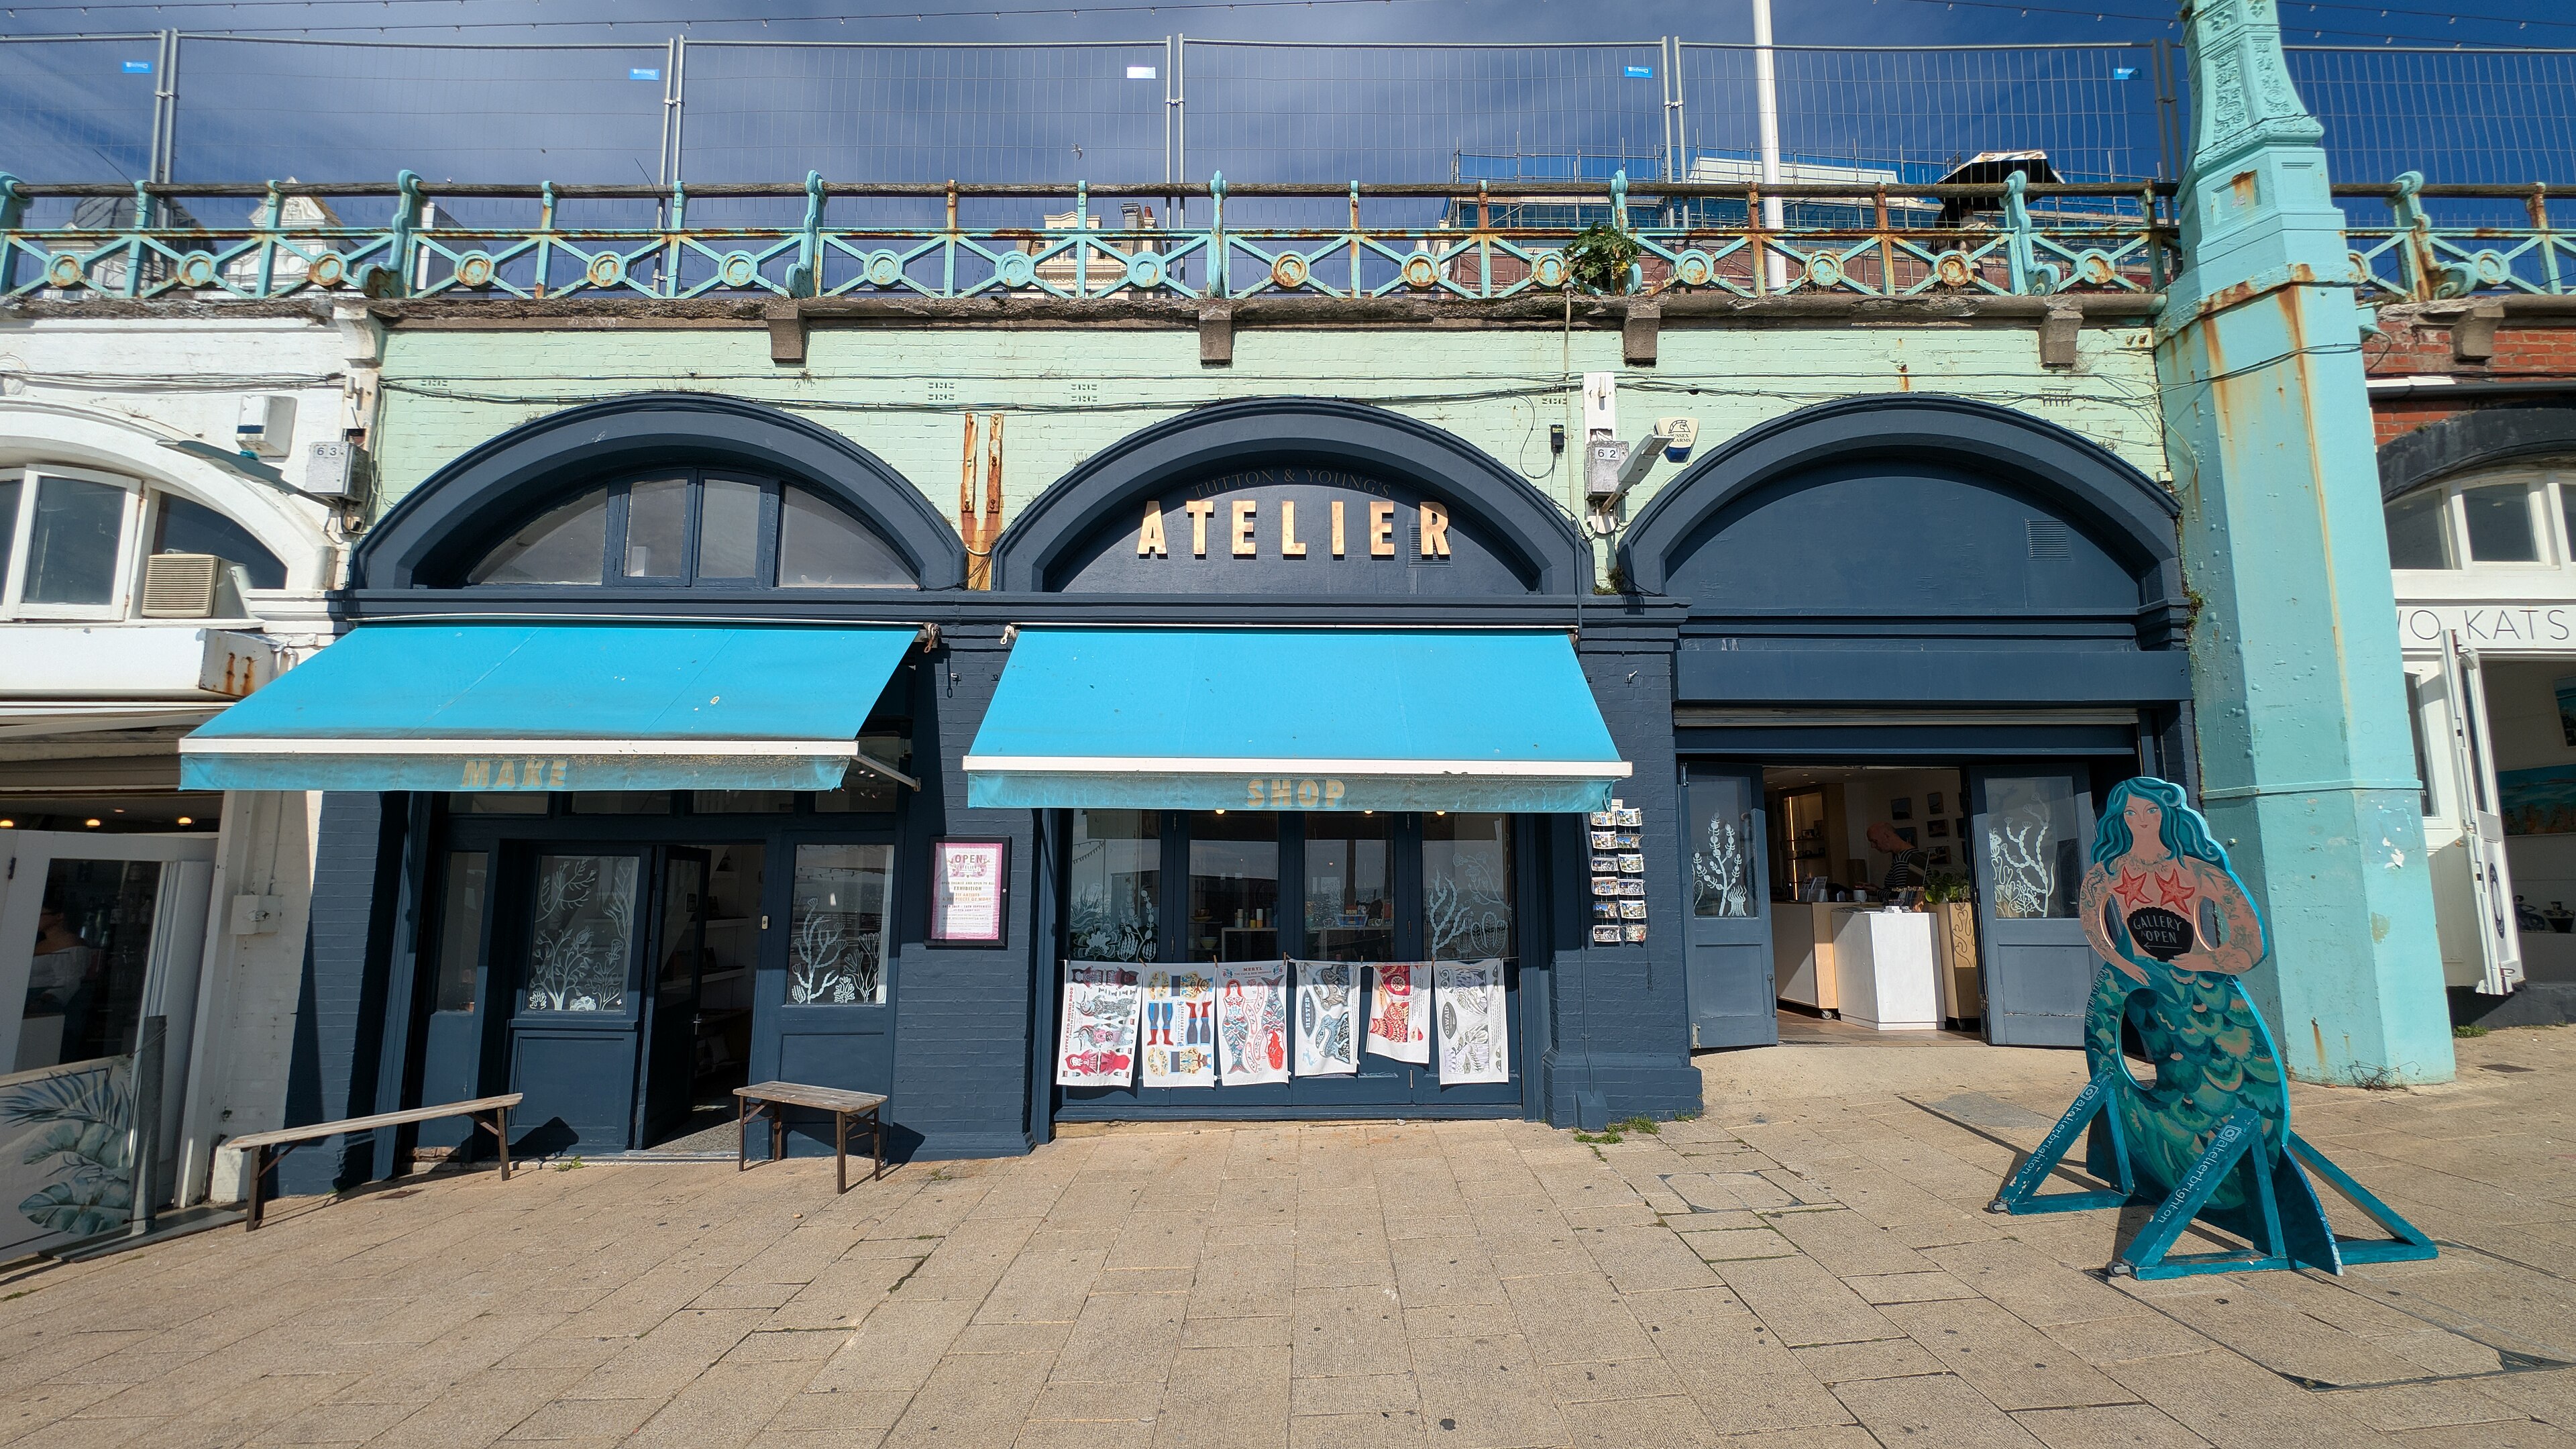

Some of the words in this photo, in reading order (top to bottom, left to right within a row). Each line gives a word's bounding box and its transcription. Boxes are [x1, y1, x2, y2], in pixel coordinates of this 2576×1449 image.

[317, 447, 337, 455] 63
[1598, 449, 1616, 458] 62
[1191, 470, 1274, 498] TUTTON
[1284, 469, 1295, 482] &
[1307, 470, 1391, 497] YOUNG'S
[1136, 500, 1451, 555] ATELIER
[2464, 610, 2569, 640] KATS
[461, 759, 568, 787] MAKE
[1247, 779, 1345, 806] SHOP
[955, 854, 983, 863] OPEN
[2133, 914, 2182, 931] GALLERY
[2146, 930, 2178, 944] OPEN
[2022, 1099, 2085, 1175] atelierbrighton
[2157, 1140, 2228, 1223] atelierbrighton
